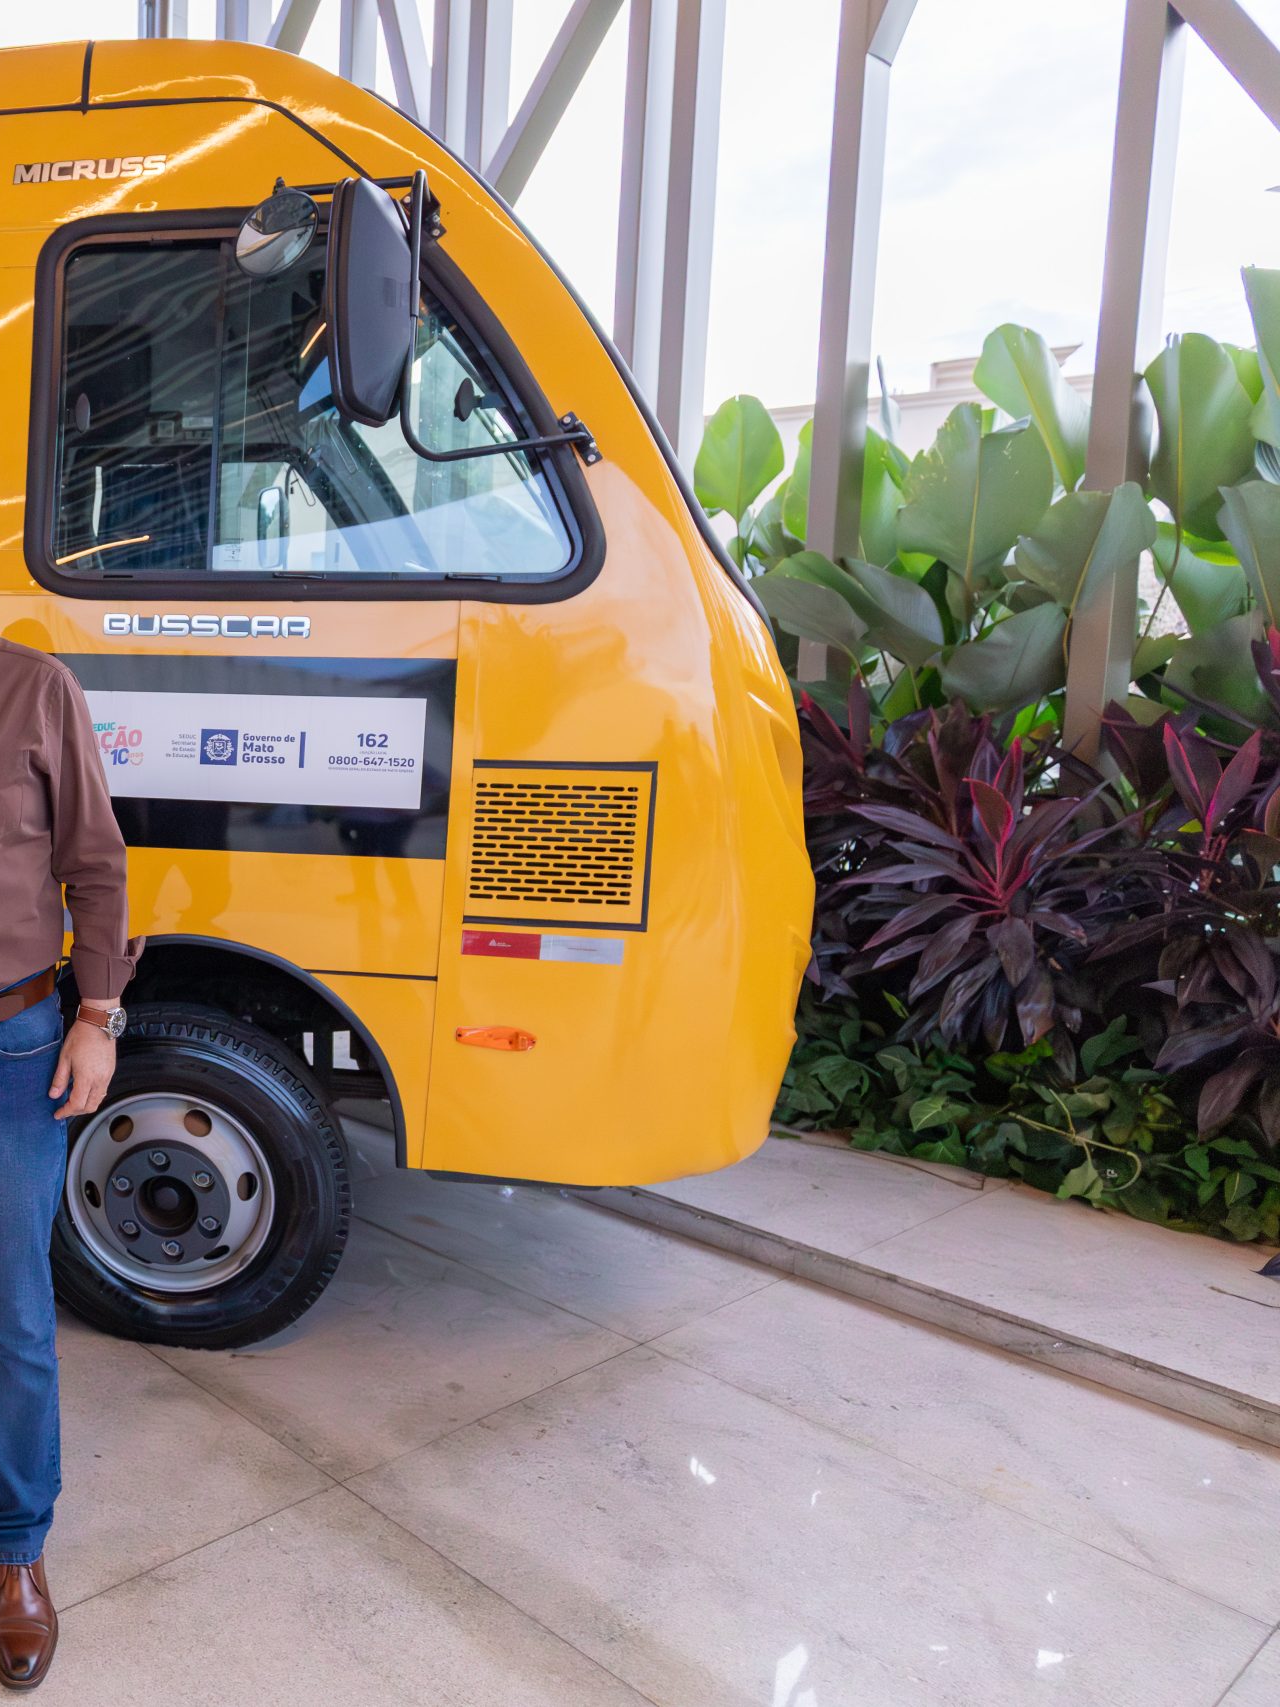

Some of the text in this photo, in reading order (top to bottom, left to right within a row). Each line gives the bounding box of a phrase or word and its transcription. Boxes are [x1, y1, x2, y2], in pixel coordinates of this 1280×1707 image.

[13, 154, 167, 185] MICRUSS
[103, 613, 312, 639] BUSSCAR
[243, 733, 296, 743] Governo de
[357, 733, 389, 748] 162
[243, 742, 275, 753] Mato
[242, 753, 286, 764] Grosso
[328, 755, 415, 768] 0800-647-1520
